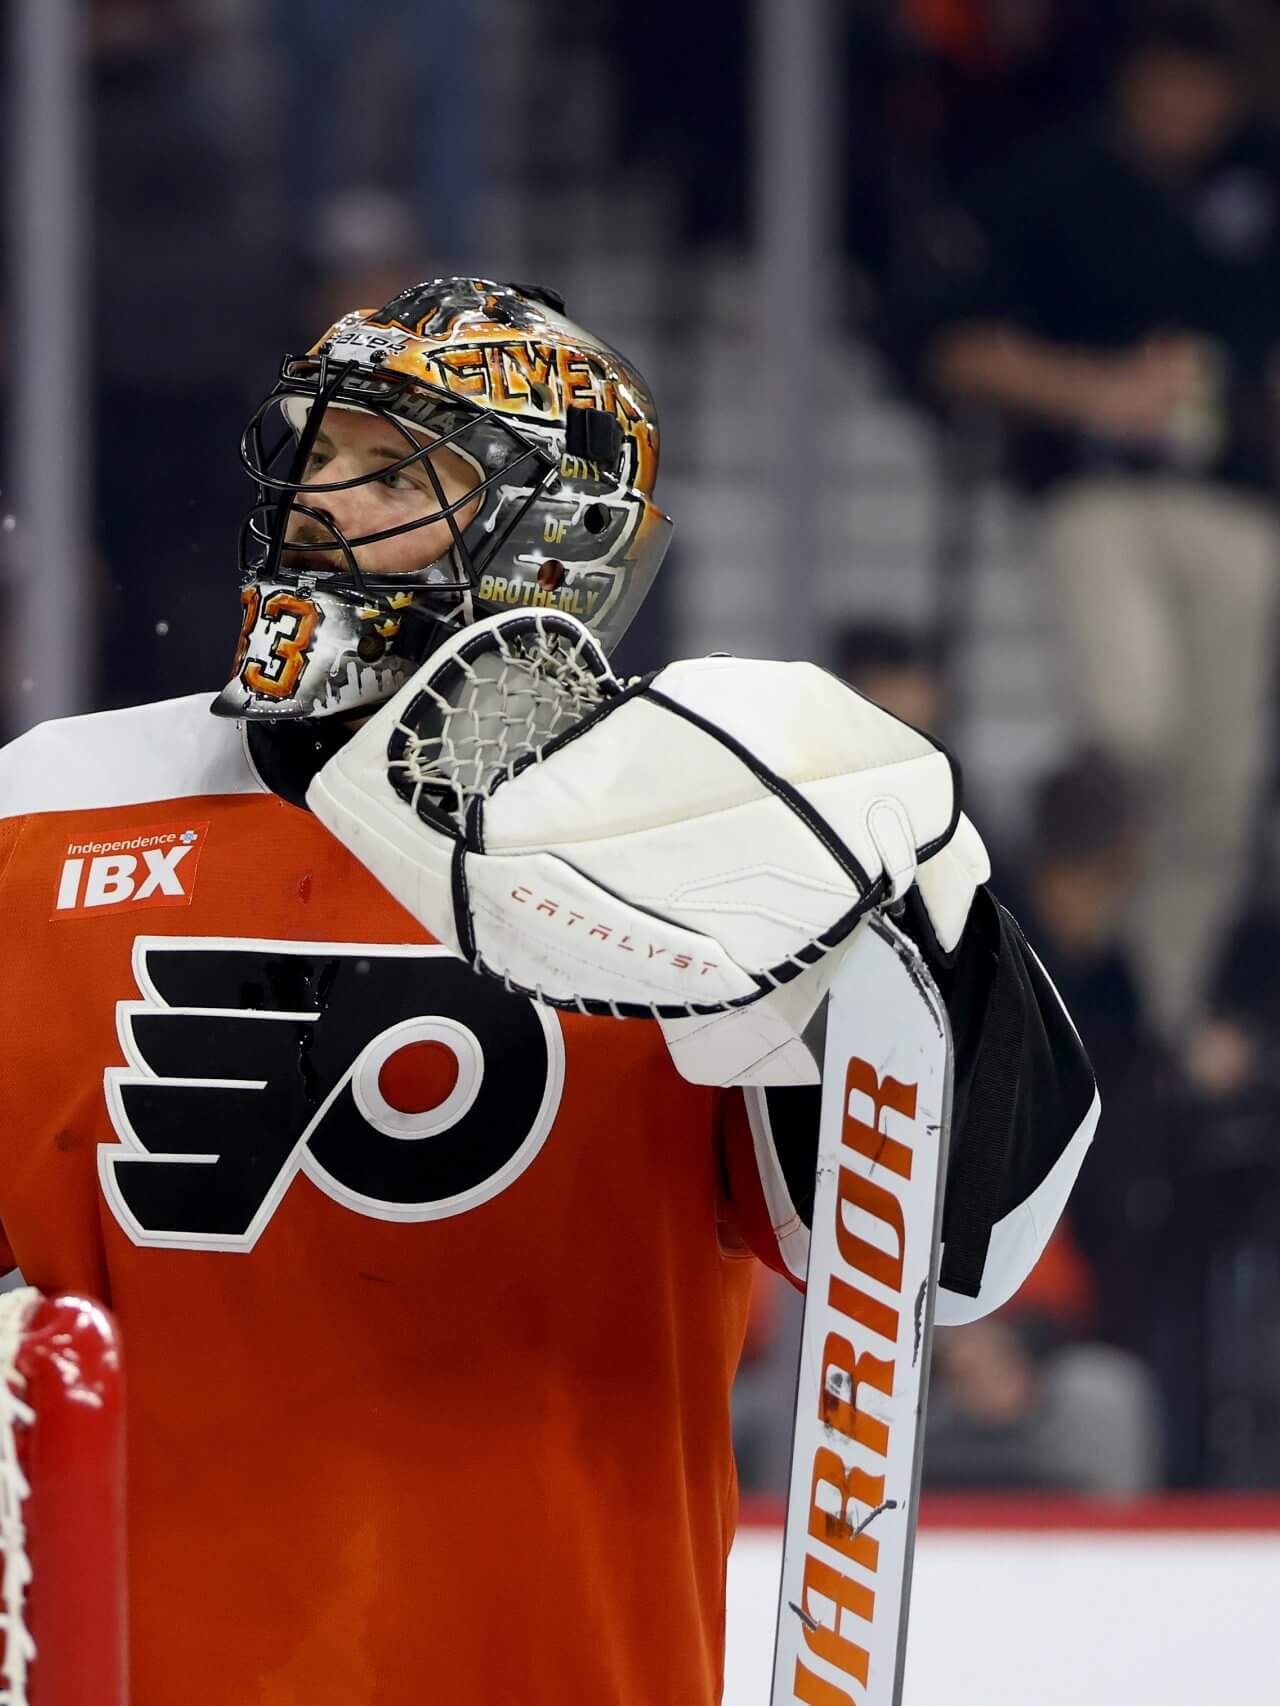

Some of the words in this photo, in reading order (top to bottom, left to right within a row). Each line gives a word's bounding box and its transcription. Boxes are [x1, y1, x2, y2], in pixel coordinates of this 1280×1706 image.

[332, 332, 408, 356] AUER
[560, 452, 601, 482] CITY
[543, 518, 571, 544] OF
[478, 574, 600, 615] BROTHERLY
[67, 832, 177, 855] Independence
[56, 845, 194, 910] IBX
[511, 886, 719, 976] CATALYST
